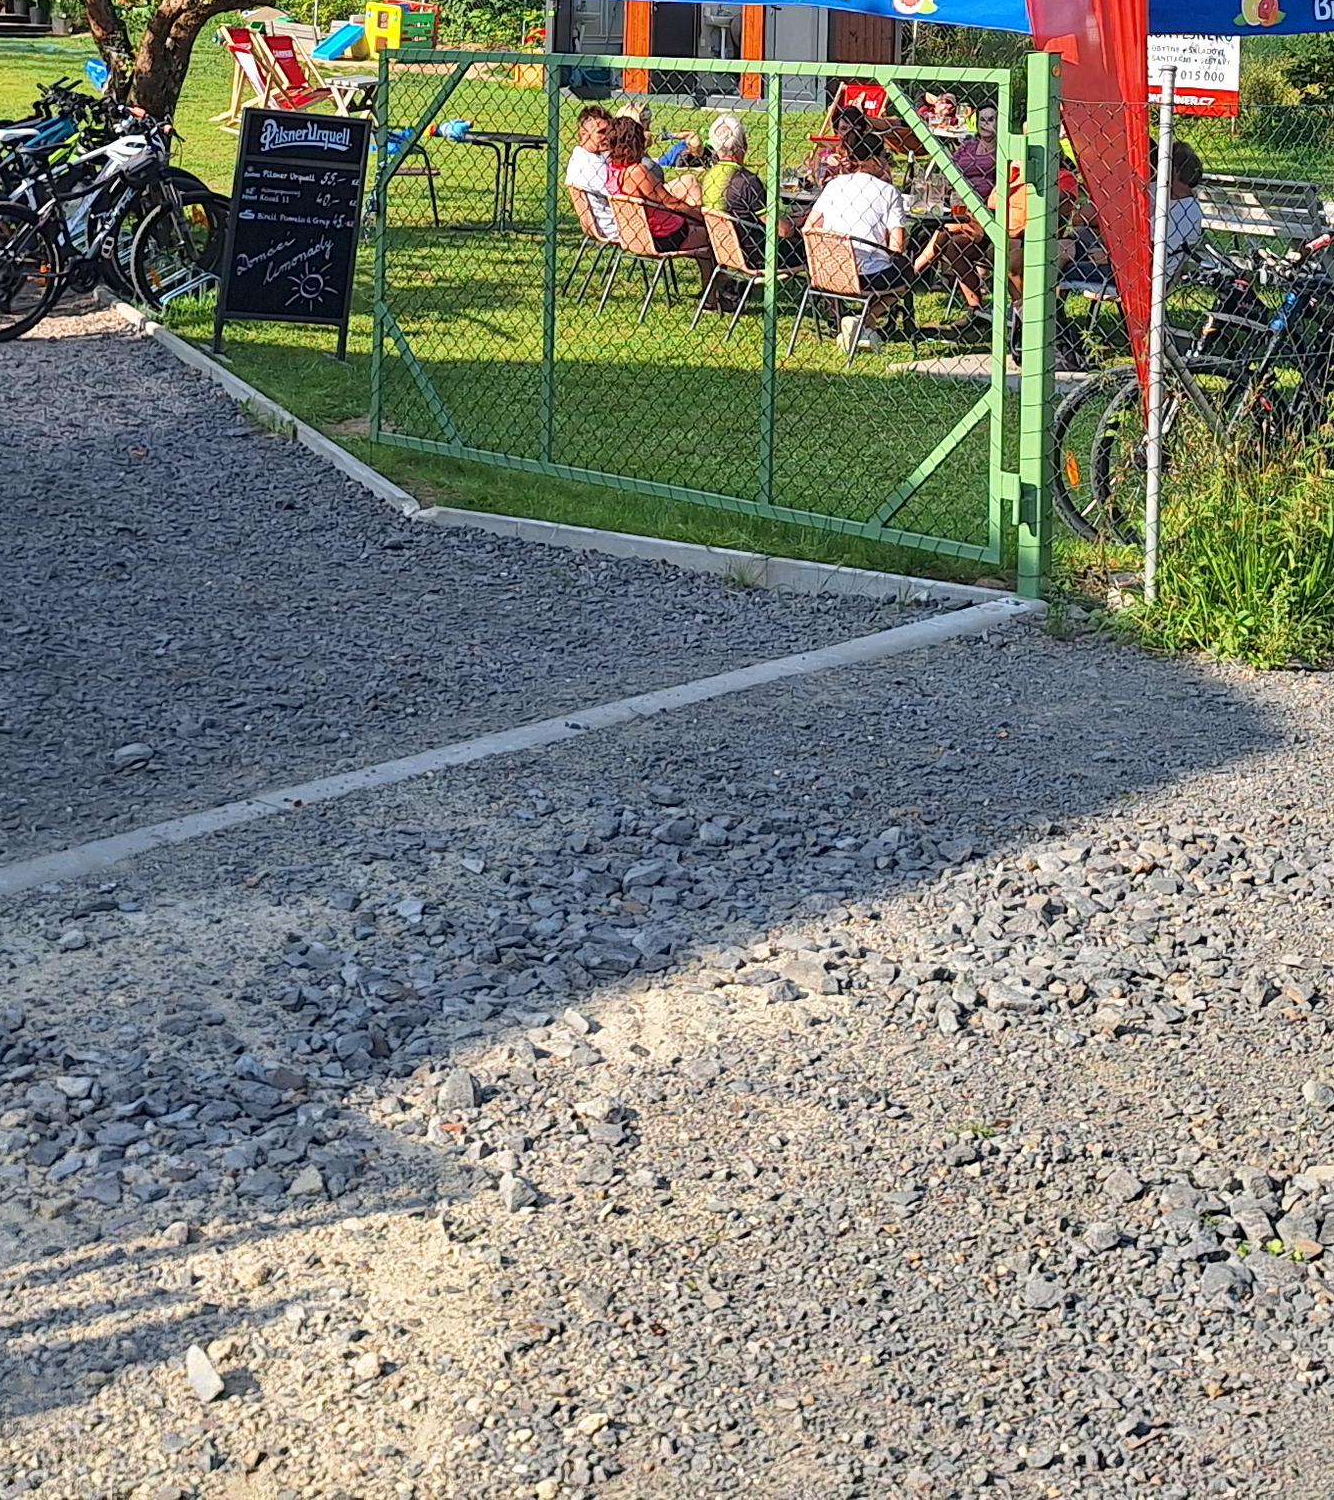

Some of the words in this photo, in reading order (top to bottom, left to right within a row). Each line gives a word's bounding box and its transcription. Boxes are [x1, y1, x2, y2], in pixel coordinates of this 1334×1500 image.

[1180, 70, 1201, 81] 015
[1204, 71, 1225, 83] 000
[260, 118, 308, 152] Pilsner
[307, 121, 351, 150] Urquell
